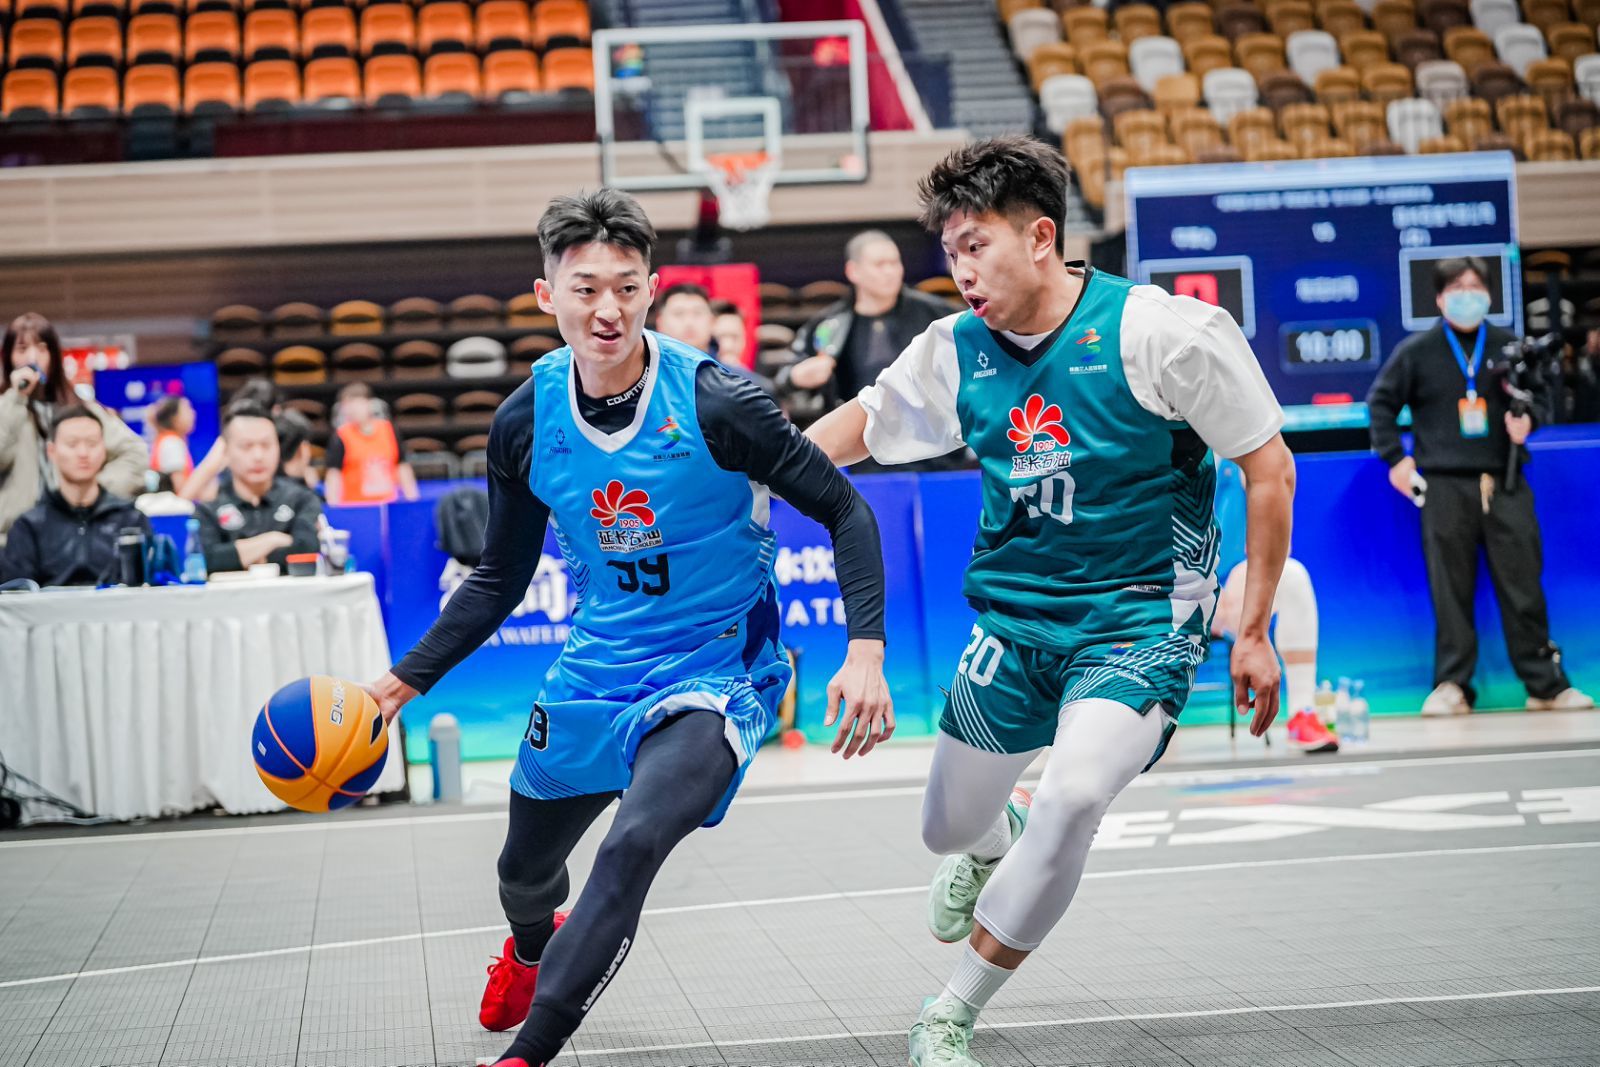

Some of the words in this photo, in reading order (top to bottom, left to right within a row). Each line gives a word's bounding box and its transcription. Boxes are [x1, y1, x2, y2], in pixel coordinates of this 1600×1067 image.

[1034, 441, 1055, 452] 1905
[1013, 452, 1071, 472] 延长石油
[619, 519, 640, 528] 1905
[957, 622, 1005, 687] 20
